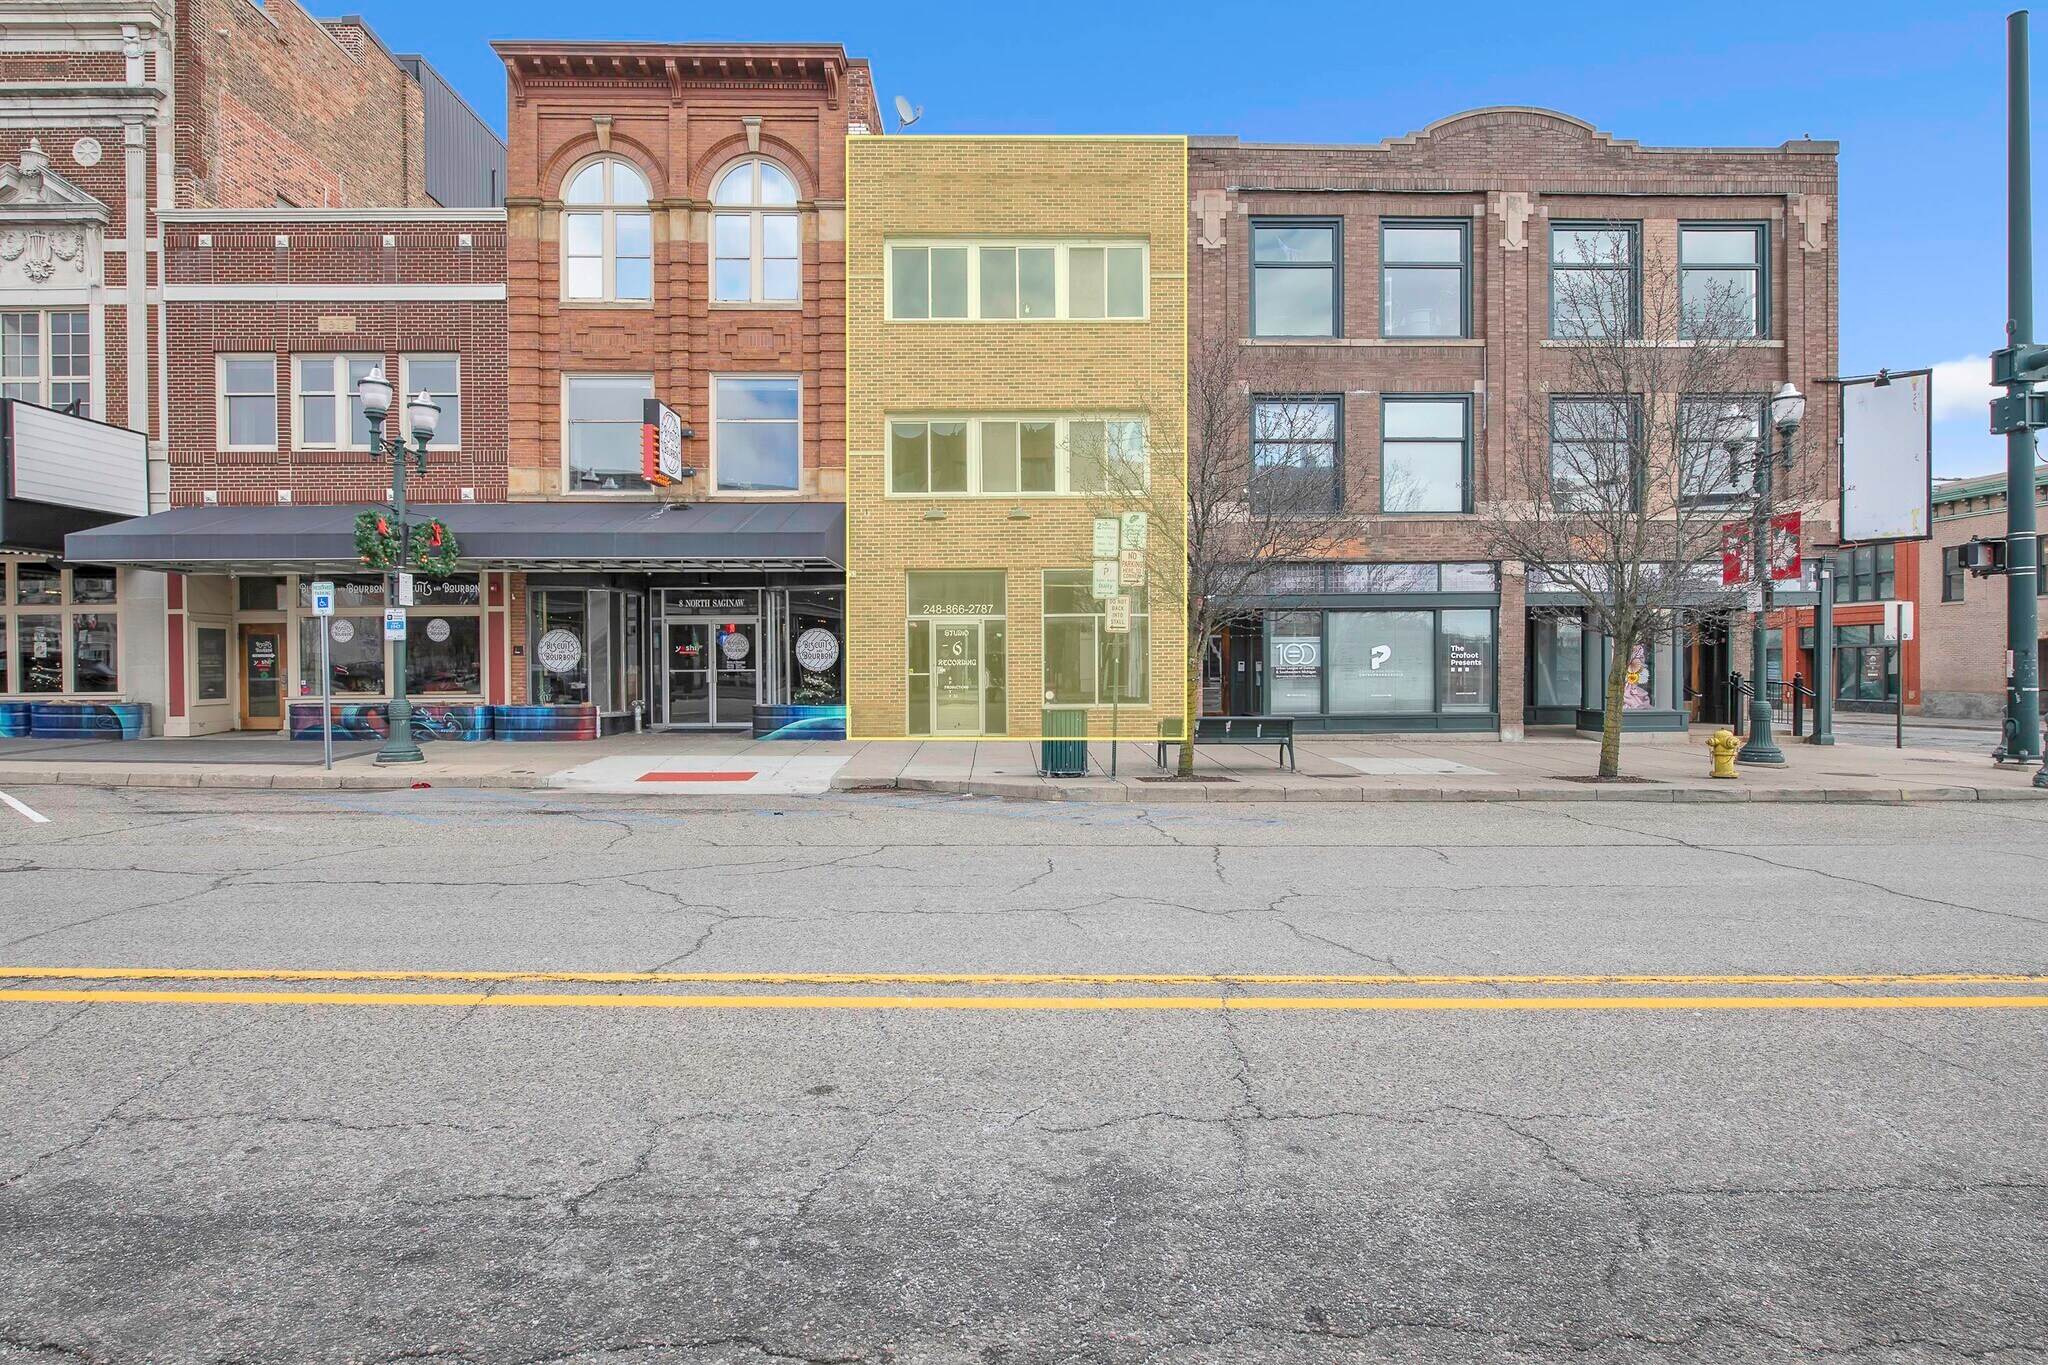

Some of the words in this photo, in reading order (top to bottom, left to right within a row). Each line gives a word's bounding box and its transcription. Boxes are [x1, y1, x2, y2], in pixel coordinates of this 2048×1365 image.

[1096, 522, 1102, 530] 2
[1128, 552, 1137, 560] NO
[679, 599, 684, 608] 8
[685, 599, 710, 608] NORTH
[712, 599, 745, 608] SAGINAW
[923, 603, 994, 614] 248-866-2787
[944, 628, 969, 637] STUDIO
